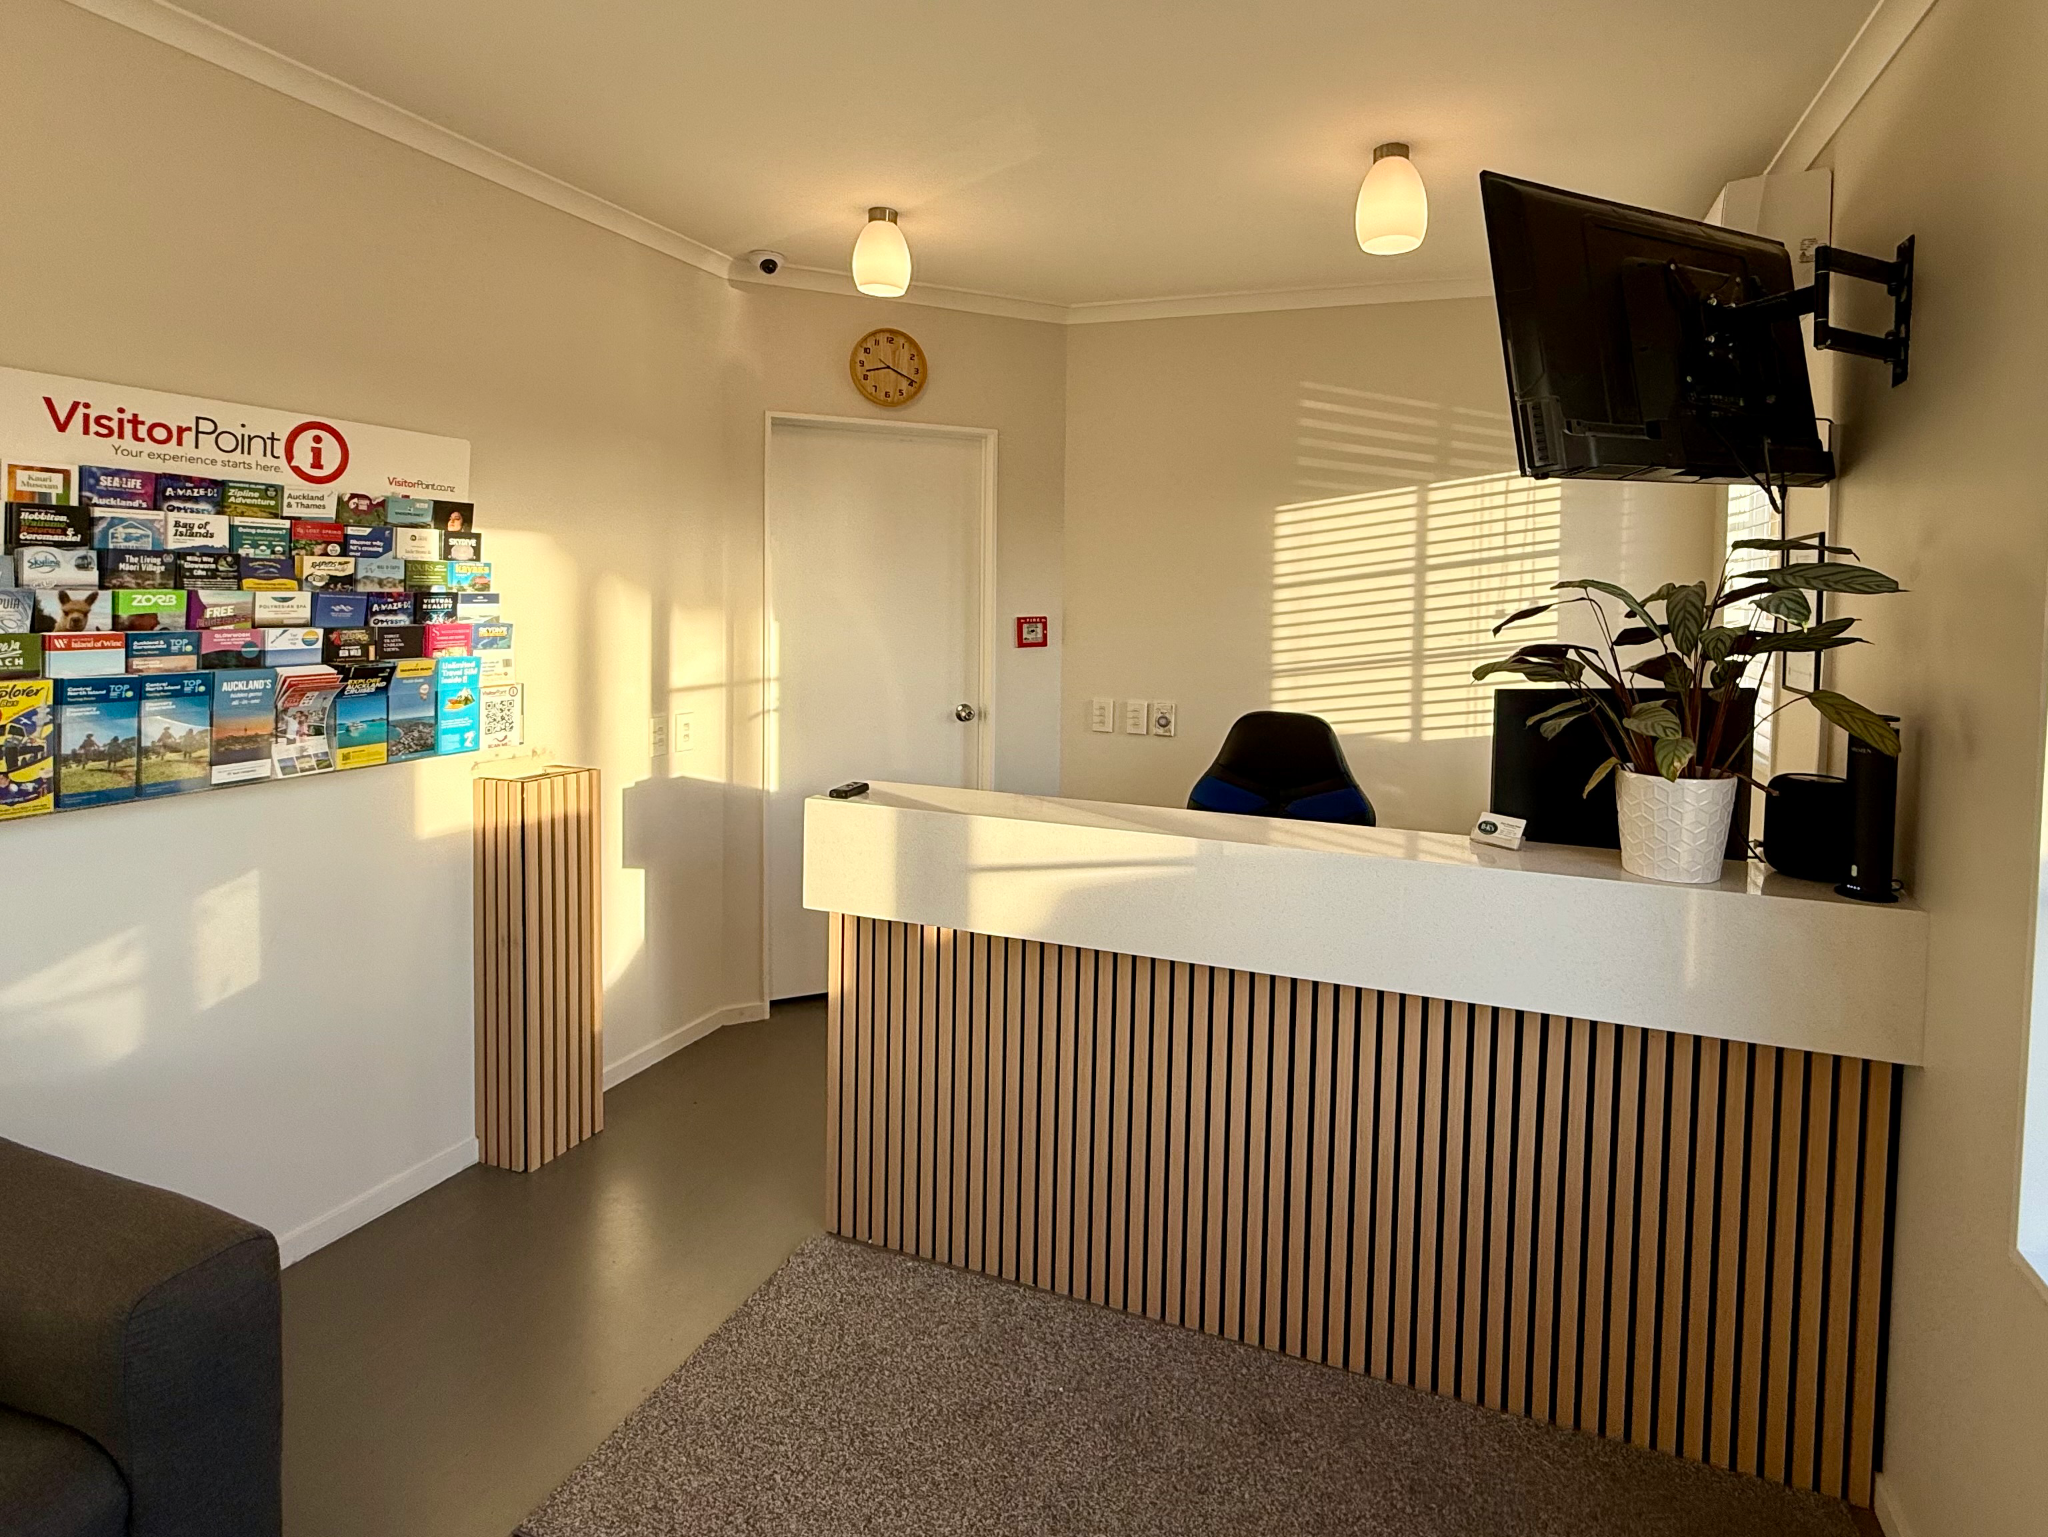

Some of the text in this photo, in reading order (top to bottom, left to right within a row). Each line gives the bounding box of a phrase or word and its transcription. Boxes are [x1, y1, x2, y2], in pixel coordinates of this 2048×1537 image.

[863, 347, 871, 355] 10
[914, 367, 920, 375] 3
[872, 385, 878, 393] 7
[42, 396, 281, 459] VisitorPoint
[111, 443, 284, 474] Your experience starts here.
[27, 474, 52, 483] Kauri
[20, 480, 59, 490] Museum
[227, 488, 260, 498] Zipline
[286, 492, 325, 502] Auckland
[91, 496, 148, 508] Auckland's
[227, 496, 276, 506] Adventure
[295, 502, 326, 511] Thames
[173, 520, 210, 531] Bay of
[172, 528, 215, 539] Islands
[124, 554, 161, 564] The Living
[141, 563, 165, 573] Village
[204, 605, 235, 618] FREE
[222, 679, 272, 692] AUCKLAND'S
